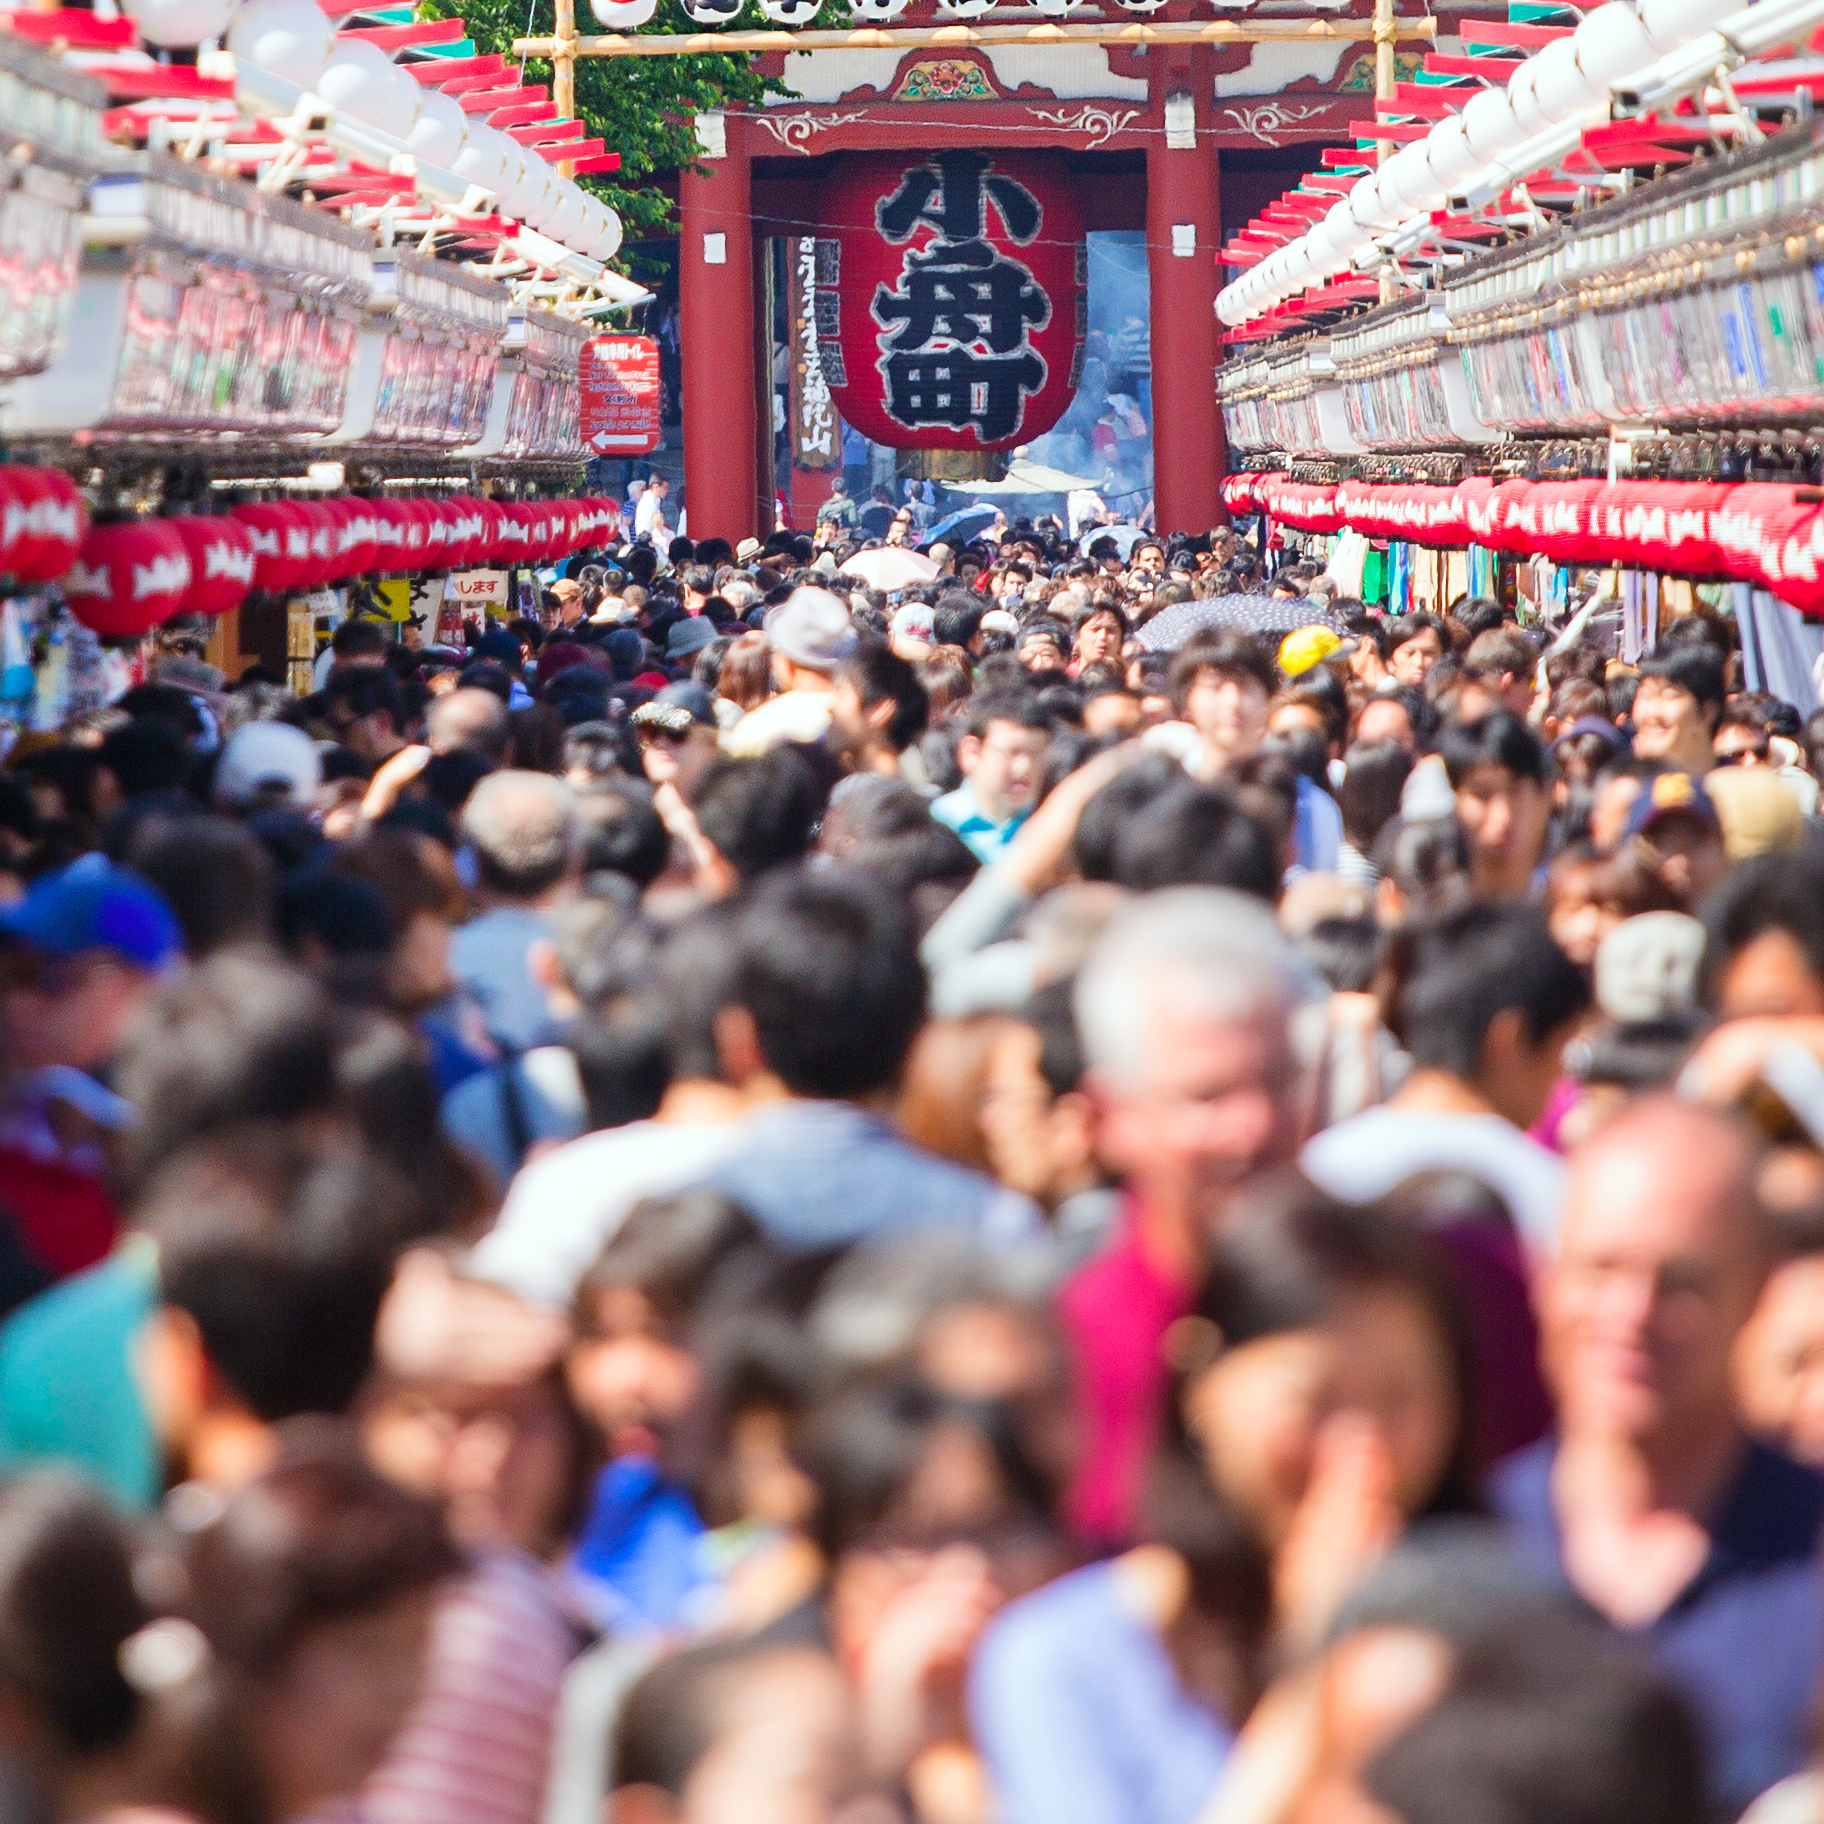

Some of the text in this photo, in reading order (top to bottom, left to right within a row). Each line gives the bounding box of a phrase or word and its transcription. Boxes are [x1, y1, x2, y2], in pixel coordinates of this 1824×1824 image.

[869, 148, 1053, 443] 小舟町
[460, 579, 498, 595] します
